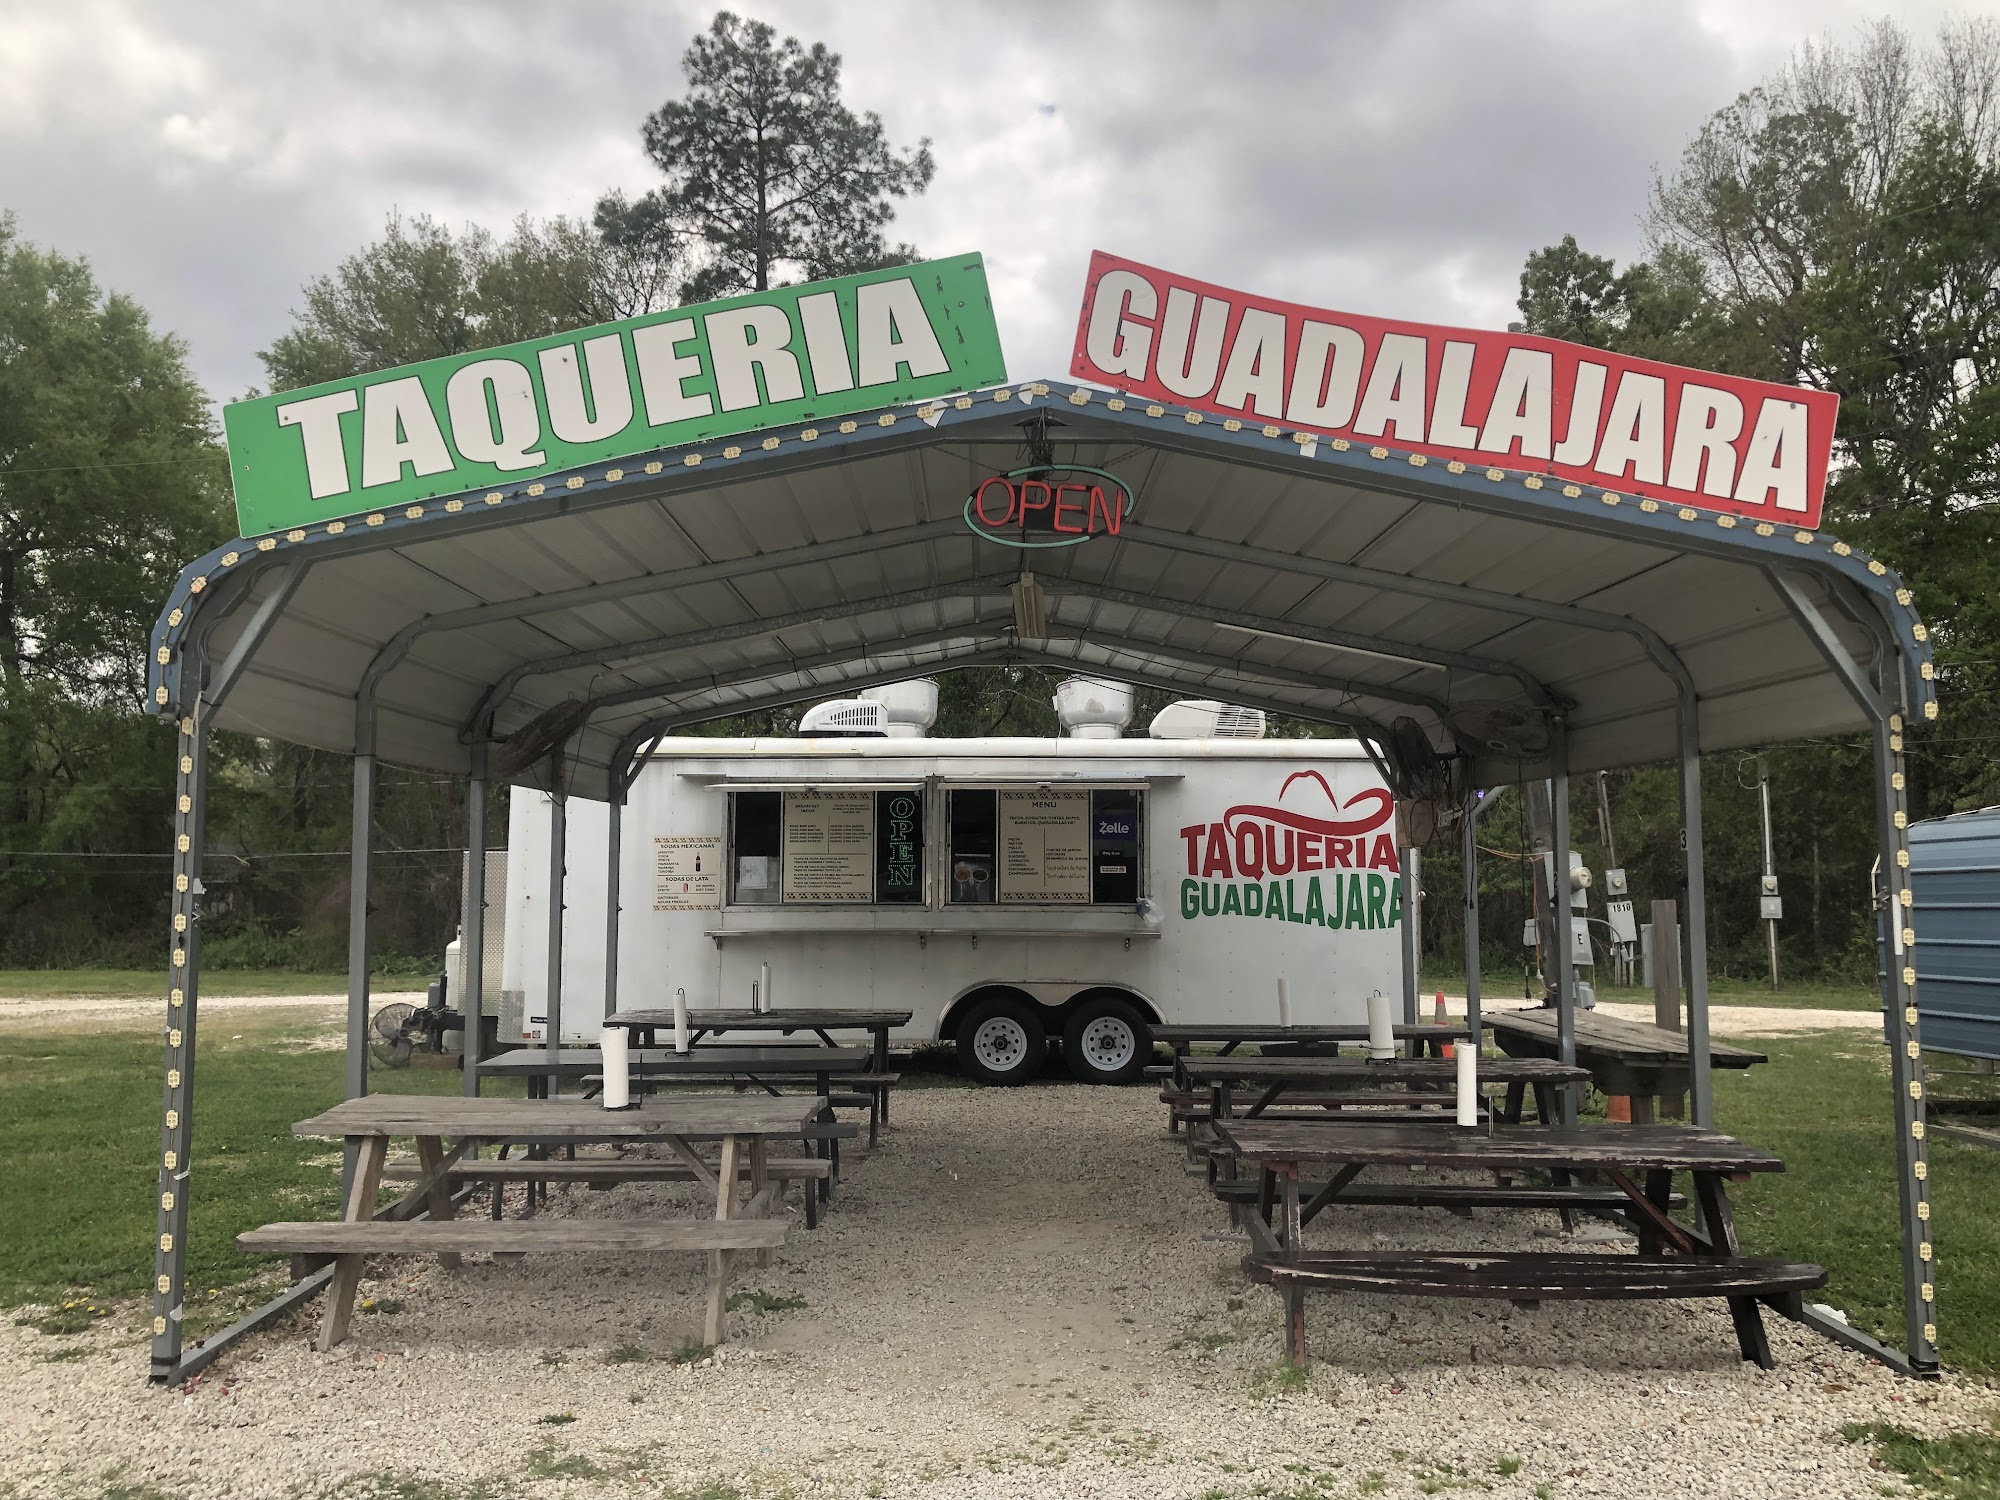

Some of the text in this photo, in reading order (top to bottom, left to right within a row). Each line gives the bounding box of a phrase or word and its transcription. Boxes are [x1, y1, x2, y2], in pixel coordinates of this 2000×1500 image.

[276, 277, 951, 500] TAQUERIA
[1085, 269, 1809, 513] GUADALAJARA
[976, 476, 1123, 535] OPEN
[888, 797, 916, 886] OPEN
[1099, 821, 1130, 834] Zelle
[1180, 821, 1401, 882] TAQUERIA
[1681, 830, 1687, 848] 3
[1180, 873, 1401, 930] GUADALAJARA
